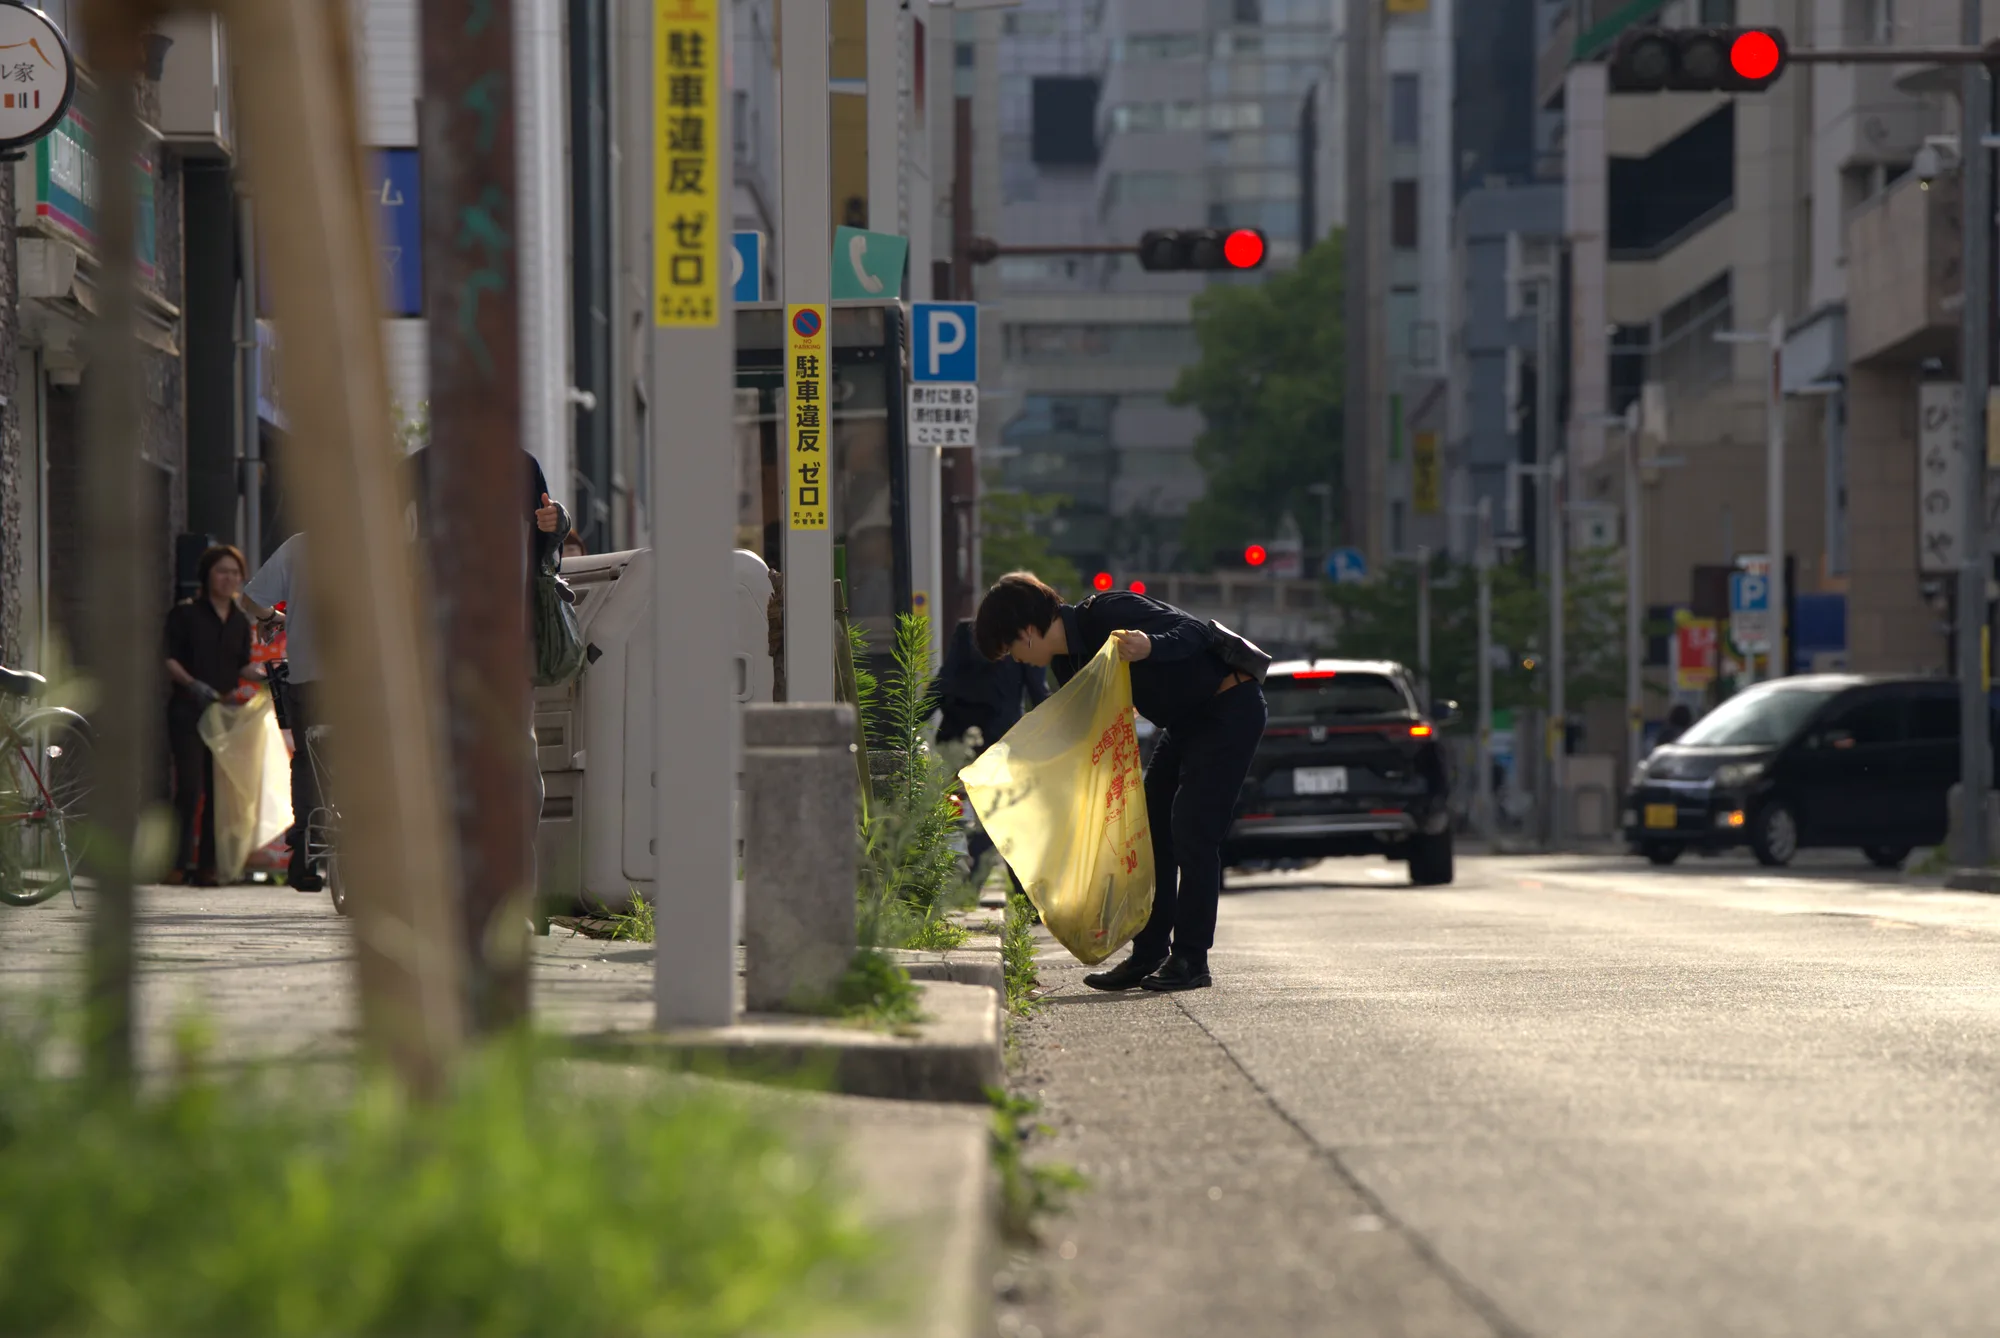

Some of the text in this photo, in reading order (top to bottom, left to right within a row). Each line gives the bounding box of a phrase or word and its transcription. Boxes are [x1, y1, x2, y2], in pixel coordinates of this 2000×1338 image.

[665, 29, 706, 196] 駐車違反
[669, 212, 706, 287] ゼロ
[929, 310, 966, 375] P
[796, 355, 821, 506] 駐車違反 ゼロ
[917, 427, 970, 444] ここまで
[1741, 577, 1765, 608] P
